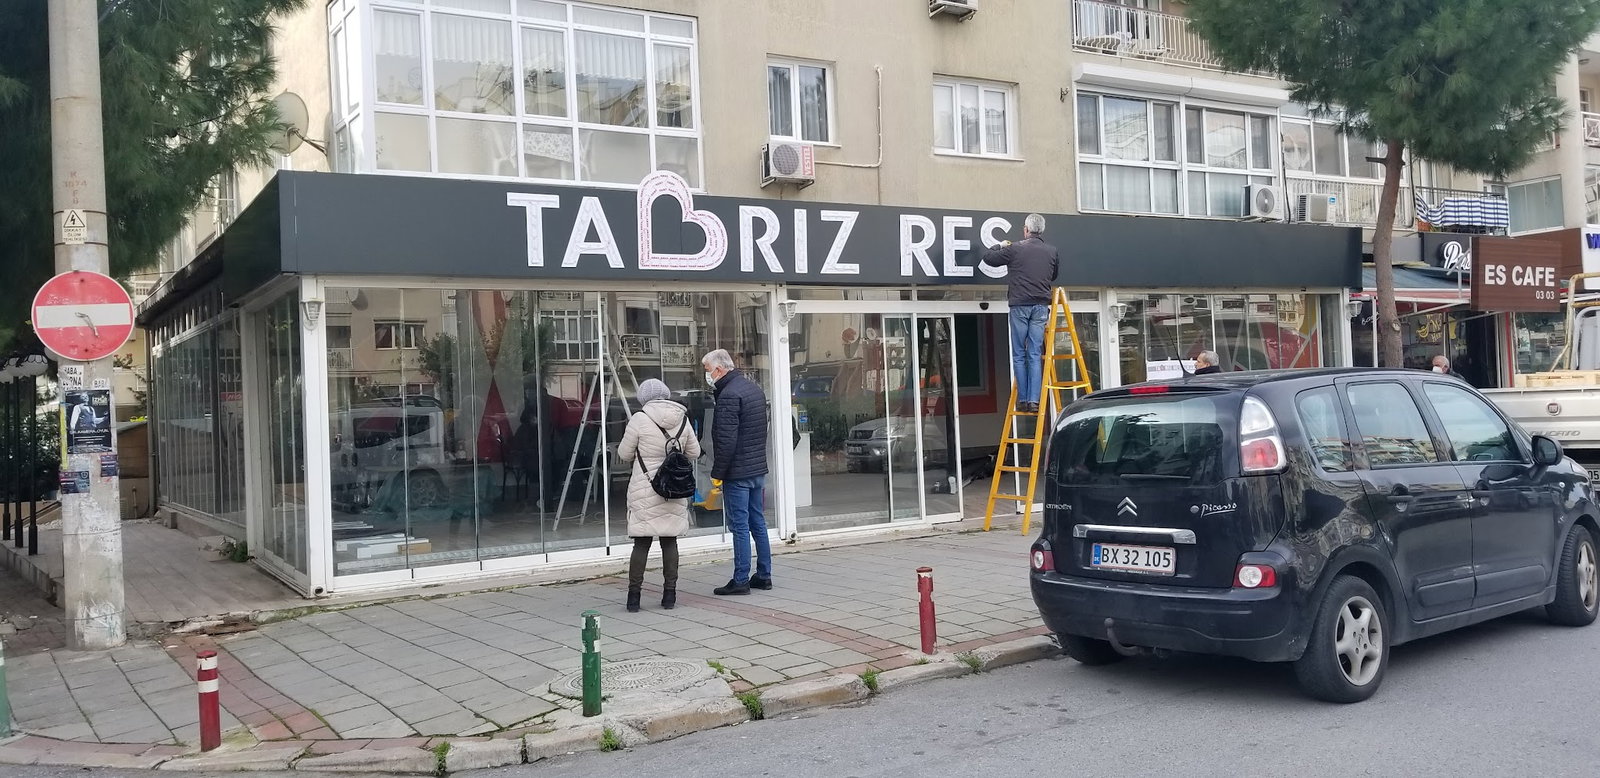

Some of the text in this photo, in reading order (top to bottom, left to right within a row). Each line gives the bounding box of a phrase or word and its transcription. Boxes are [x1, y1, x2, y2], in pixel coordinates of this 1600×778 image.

[506, 170, 860, 276] TABRIZ
[1484, 264, 1555, 287] ES CAFE
[1535, 290, 1555, 300] 03 03
[1101, 547, 1171, 568] BX 32 105
